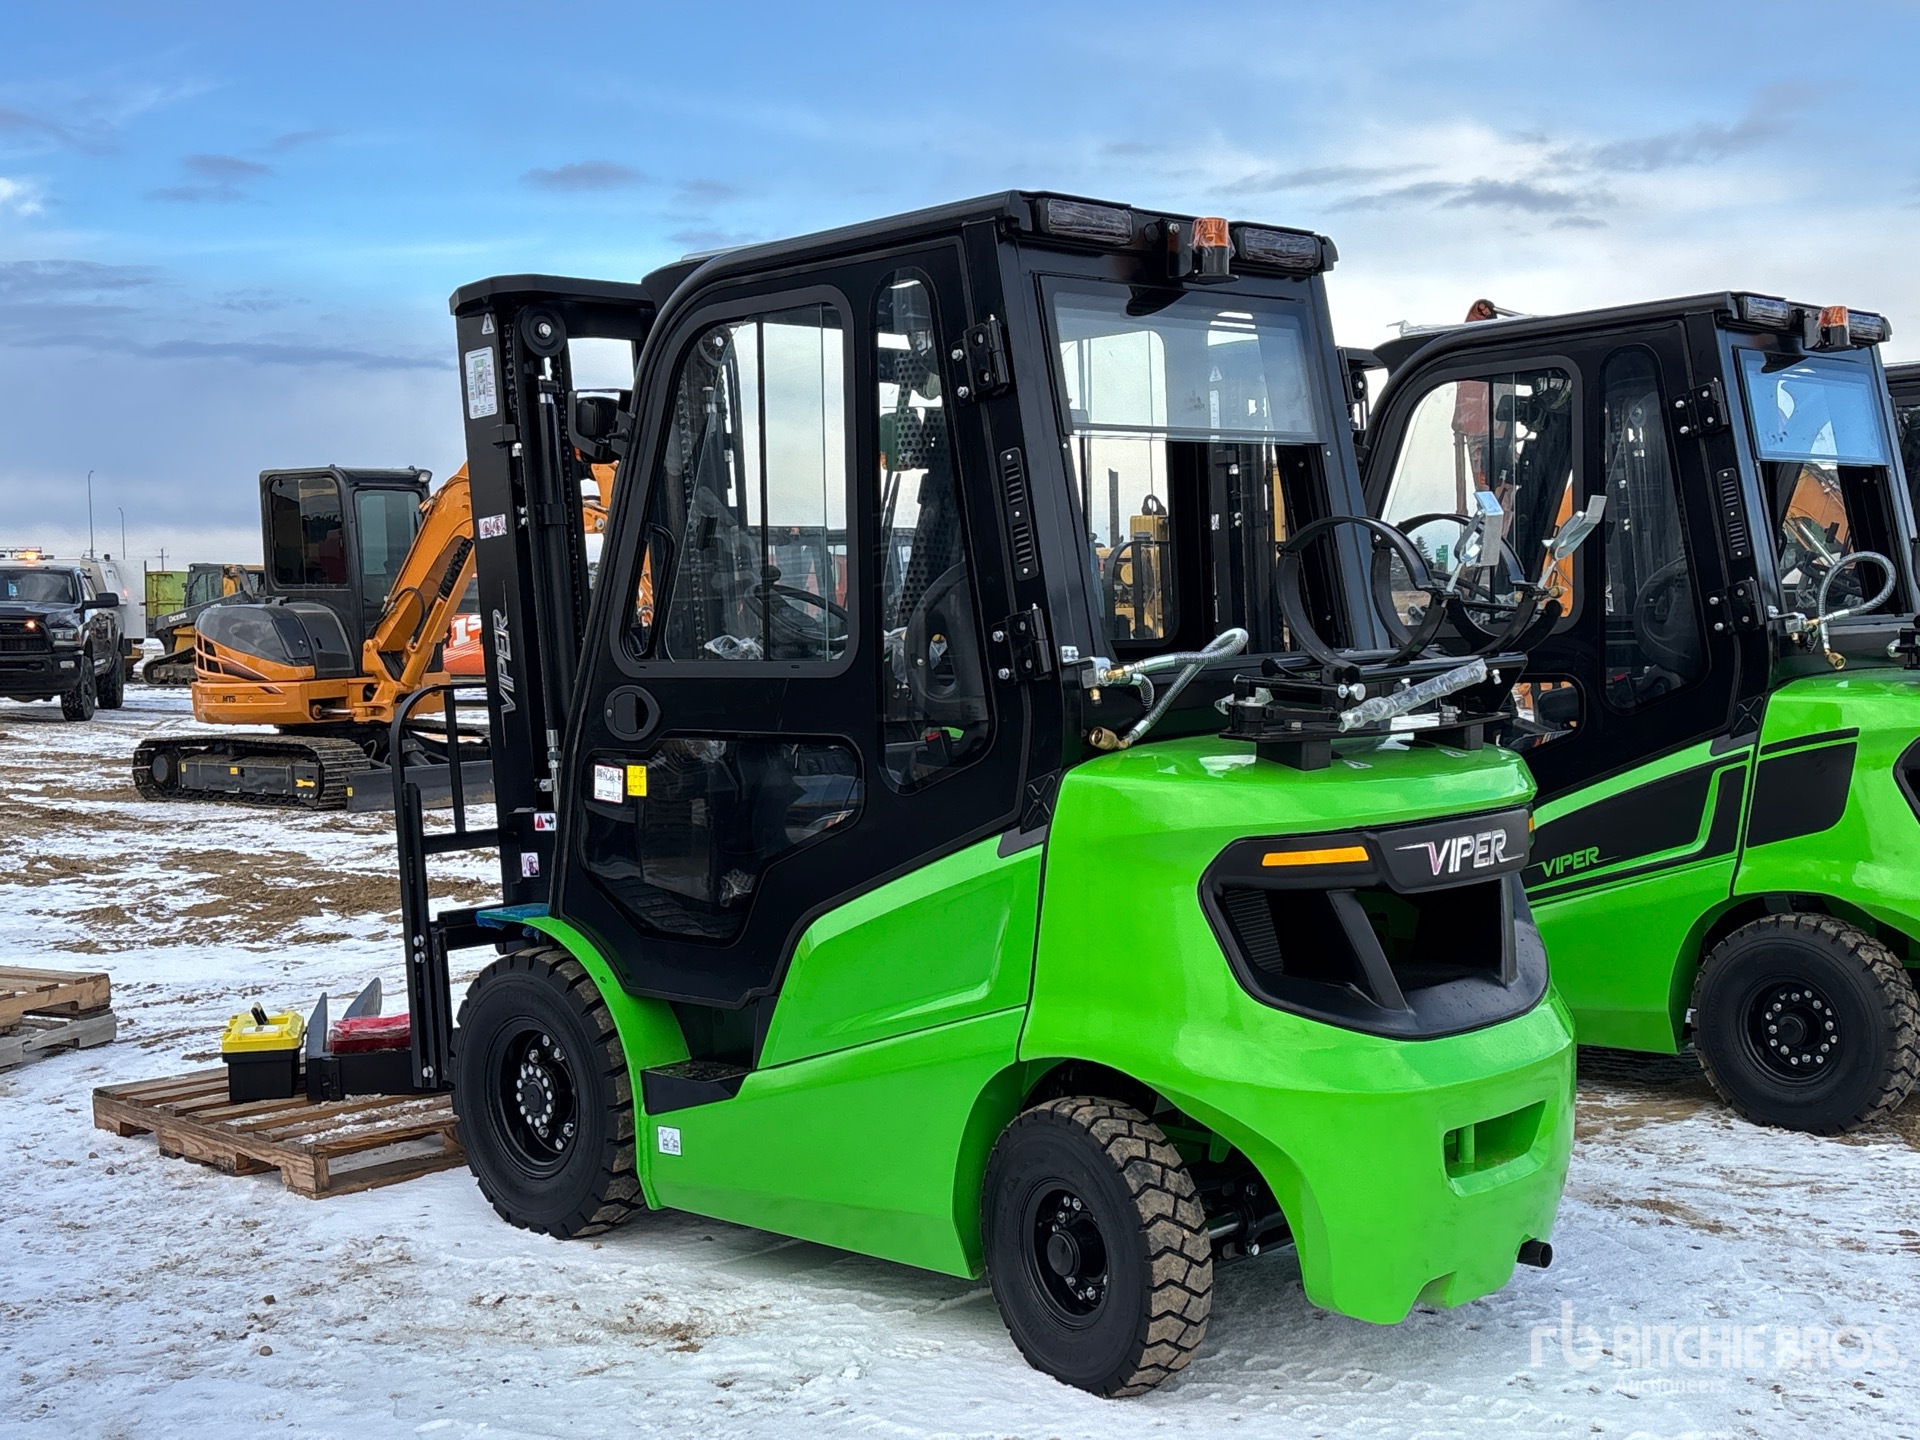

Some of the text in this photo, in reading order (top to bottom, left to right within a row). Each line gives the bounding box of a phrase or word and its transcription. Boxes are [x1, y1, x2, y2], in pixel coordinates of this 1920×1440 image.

[492, 596, 516, 726] VIPER
[1412, 828, 1518, 876] VIPER
[1535, 846, 1608, 877] VIPER
